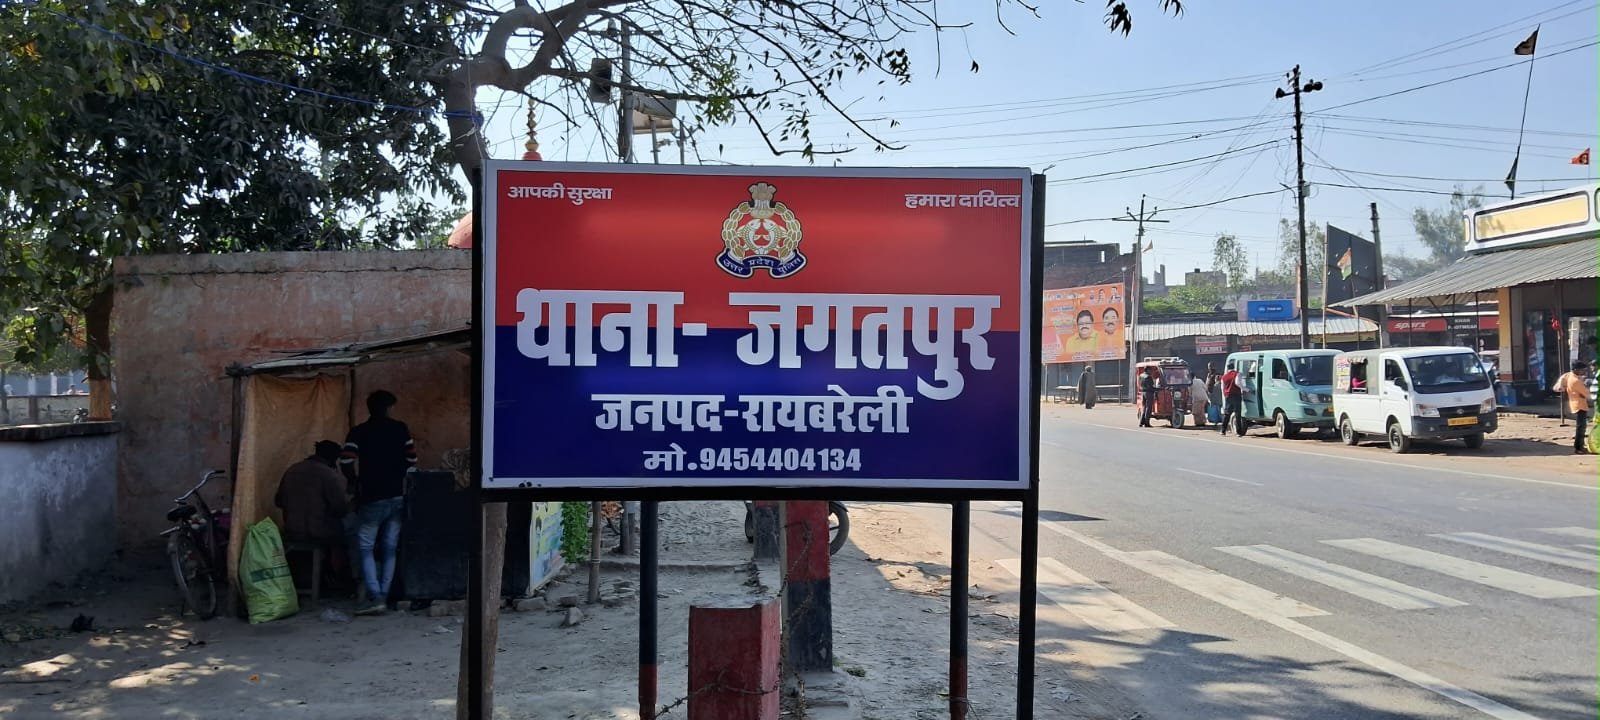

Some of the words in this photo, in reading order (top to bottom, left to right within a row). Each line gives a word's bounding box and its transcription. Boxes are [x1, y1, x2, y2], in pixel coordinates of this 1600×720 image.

[508, 183, 566, 198] आपकी
[567, 188, 613, 206] सुरक्षा
[904, 194, 957, 209] हमारा
[958, 189, 1020, 208] दायित्व
[747, 256, 775, 267] प्रदेश
[729, 293, 1001, 400] जगतपुर
[591, 385, 914, 433] जनपद-रायबरेली
